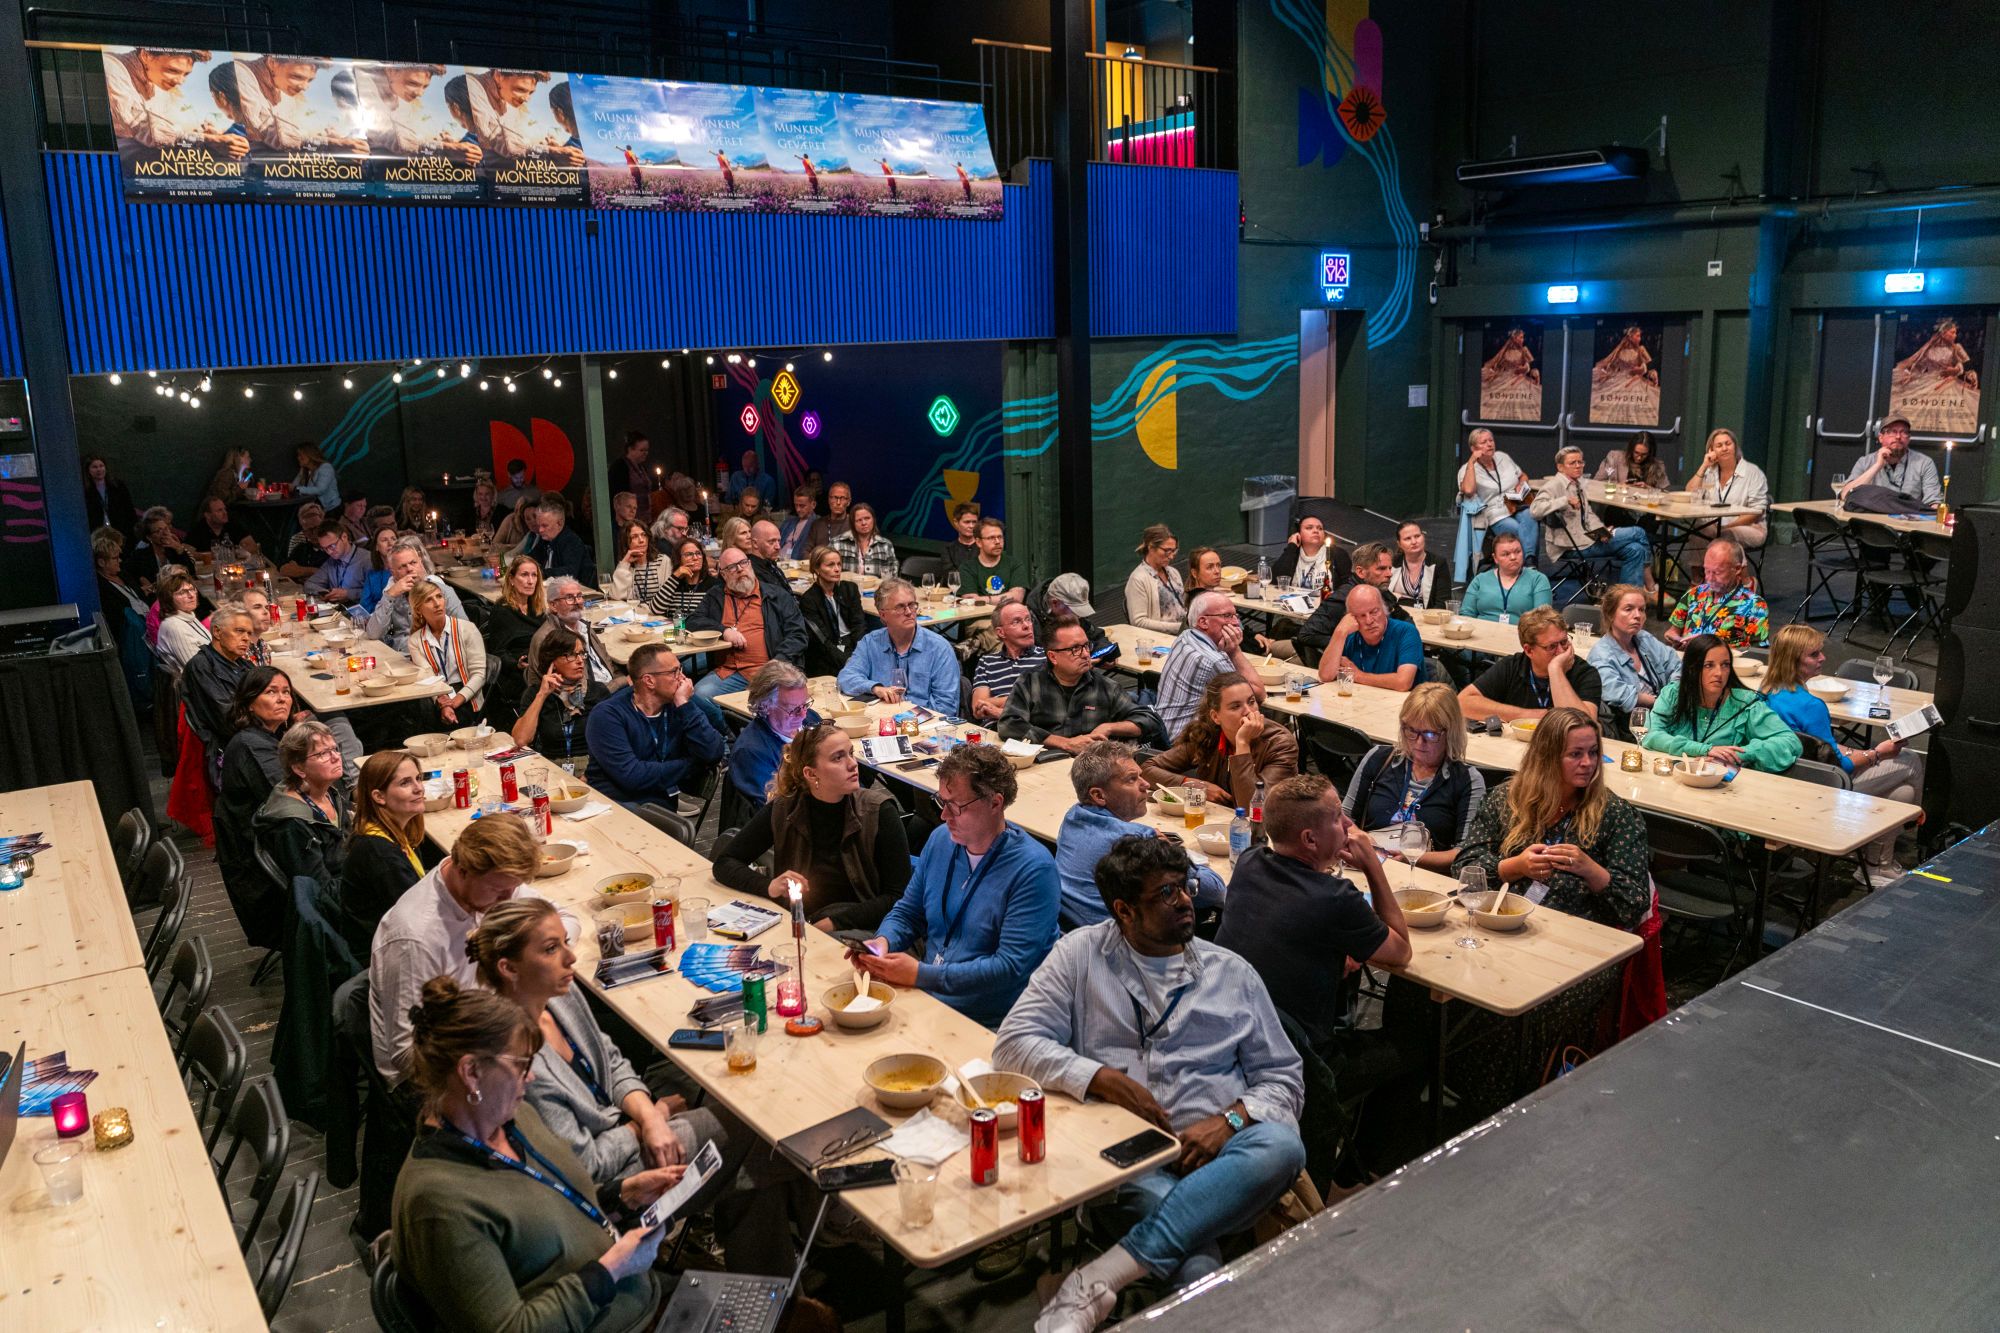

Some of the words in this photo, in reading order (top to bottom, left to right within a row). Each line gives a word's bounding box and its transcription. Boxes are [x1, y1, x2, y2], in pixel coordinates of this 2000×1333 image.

[774, 122, 824, 134] MUNKEN
[778, 138, 826, 150] GEVÆRET
[161, 148, 214, 162] MARIA
[288, 152, 338, 166] MARIA
[408, 156, 453, 168] MARIA
[516, 160, 558, 172] MARIA
[135, 161, 241, 176] MONTESSORI
[264, 163, 362, 179] MONTESSORI
[385, 168, 476, 182] MONTESSORI
[495, 170, 579, 184] MONTESSORI
[1326, 288, 1343, 301] WC
[1489, 392, 1533, 400] BØNDENE
[1600, 393, 1650, 403] BØNDENE
[1902, 398, 1966, 408] BØNDENE
